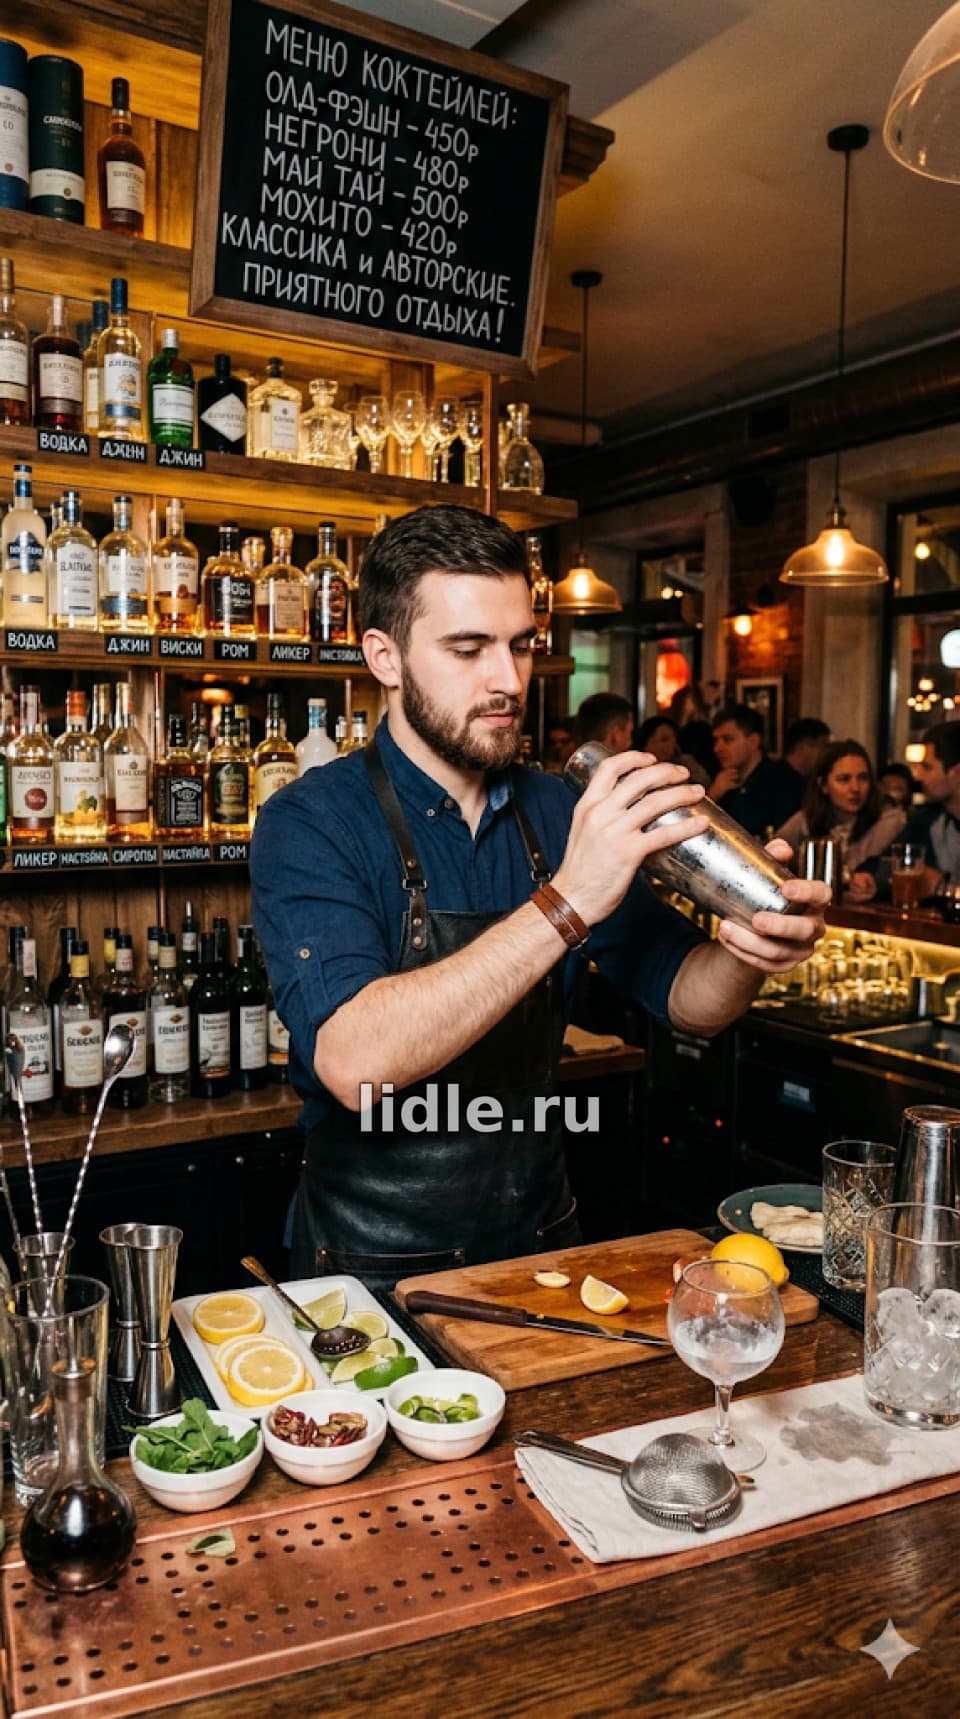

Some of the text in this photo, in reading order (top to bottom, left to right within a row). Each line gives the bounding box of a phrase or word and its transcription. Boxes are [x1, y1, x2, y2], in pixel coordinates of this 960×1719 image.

[265, 18, 518, 130] МЕНЮ КОКТЕЙЛЕЙ:
[265, 71, 400, 138] ОЛД-ФЭШН
[265, 109, 386, 170] НЕГРОНИ
[263, 147, 322, 190] МАЙ
[334, 164, 385, 205] ТАЙ
[261, 183, 372, 237] МОХИТО
[222, 211, 516, 307] КЛАССИКА и АВТОРСКИЕ.
[243, 261, 506, 343] ПРИЯТНОГО ОТДЫХА!
[39, 432, 88, 453] ВОДКА
[159, 449, 203, 468] ДЖИН
[7, 632, 56, 650] ВОДКА
[107, 637, 150, 653] ДЖИН
[160, 640, 203, 655] ВИСКИ
[222, 643, 249, 658] РОМ
[271, 645, 311, 660] ЛИКЕР
[14, 850, 57, 867] ЛИКЕР
[113, 848, 157, 863] СИРОПЫ
[220, 845, 247, 859] РОМ
